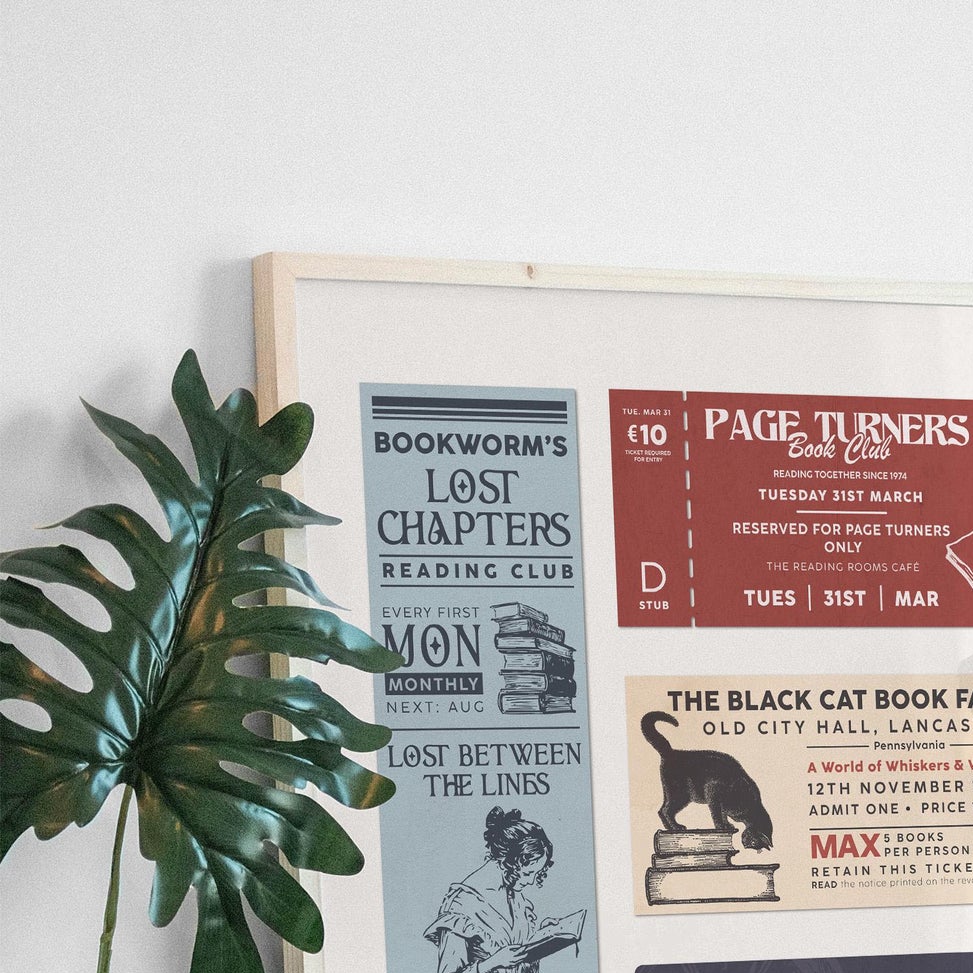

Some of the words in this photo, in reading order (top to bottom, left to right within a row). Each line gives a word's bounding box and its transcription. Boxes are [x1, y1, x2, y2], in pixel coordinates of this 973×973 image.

[705, 408, 800, 442] PAGE
[814, 411, 969, 446] TURNERS
[627, 424, 667, 445] €10
[788, 432, 836, 458] Book
[844, 432, 893, 464] Club
[774, 470, 813, 478] READING
[815, 471, 861, 479] TOGETHER
[863, 471, 888, 479] SINCE
[890, 472, 907, 480] 1974
[425, 468, 519, 504] LOST
[759, 489, 827, 500] TUESDAY
[833, 490, 864, 502] 31ST
[870, 491, 923, 503] MARCH
[378, 510, 571, 546] CHAPTERS
[732, 523, 808, 535] RESERVED
[813, 524, 840, 535] FOR
[846, 524, 881, 535] PAGE
[886, 524, 950, 536] TURNERS
[824, 542, 862, 552] ONLY
[382, 563, 498, 578] READING
[511, 564, 573, 578] CLUB
[767, 562, 789, 571] THE
[794, 562, 844, 571] READING
[848, 563, 887, 572] ROOMS
[892, 561, 919, 572] CAFÉ
[641, 562, 666, 592] D
[639, 601, 669, 609] STUB
[744, 590, 796, 606] TUES
[824, 590, 866, 606] 31ST
[895, 591, 939, 607] MAR
[382, 607, 431, 618] EVERY
[438, 607, 479, 618] FIRST
[382, 624, 481, 667] MON
[388, 678, 478, 691] MONTHLY
[387, 702, 439, 713] NEXT:
[448, 701, 484, 712] AUG
[667, 691, 719, 711] THE
[728, 690, 812, 710] BLACK
[820, 690, 867, 710] CAT
[875, 689, 948, 709] BOOK
[703, 722, 745, 735] OLD
[758, 721, 805, 734] CITY
[817, 720, 878, 735] HALL,
[874, 741, 945, 751] Pennsylvania
[388, 745, 449, 767] LOST
[459, 743, 581, 766] BETWEEN
[808, 762, 817, 773] A
[822, 761, 863, 773] World
[868, 760, 881, 772] of
[886, 759, 950, 771] Whiskers
[954, 760, 963, 770] &
[423, 774, 473, 797] THE
[482, 773, 550, 796] LINES
[808, 783, 850, 795] 12TH
[861, 781, 963, 794] NOVEMBER
[809, 804, 859, 816] ADMIT
[866, 803, 899, 814] ONE
[921, 802, 966, 814] PRICE
[884, 834, 890, 842] 5
[897, 832, 944, 842] BOOKS
[811, 833, 881, 859] MAX
[884, 847, 911, 857] PER
[916, 846, 970, 856] PERSON
[812, 866, 870, 876] RETAIN
[880, 864, 917, 875] THIS
[812, 881, 837, 889] READ
